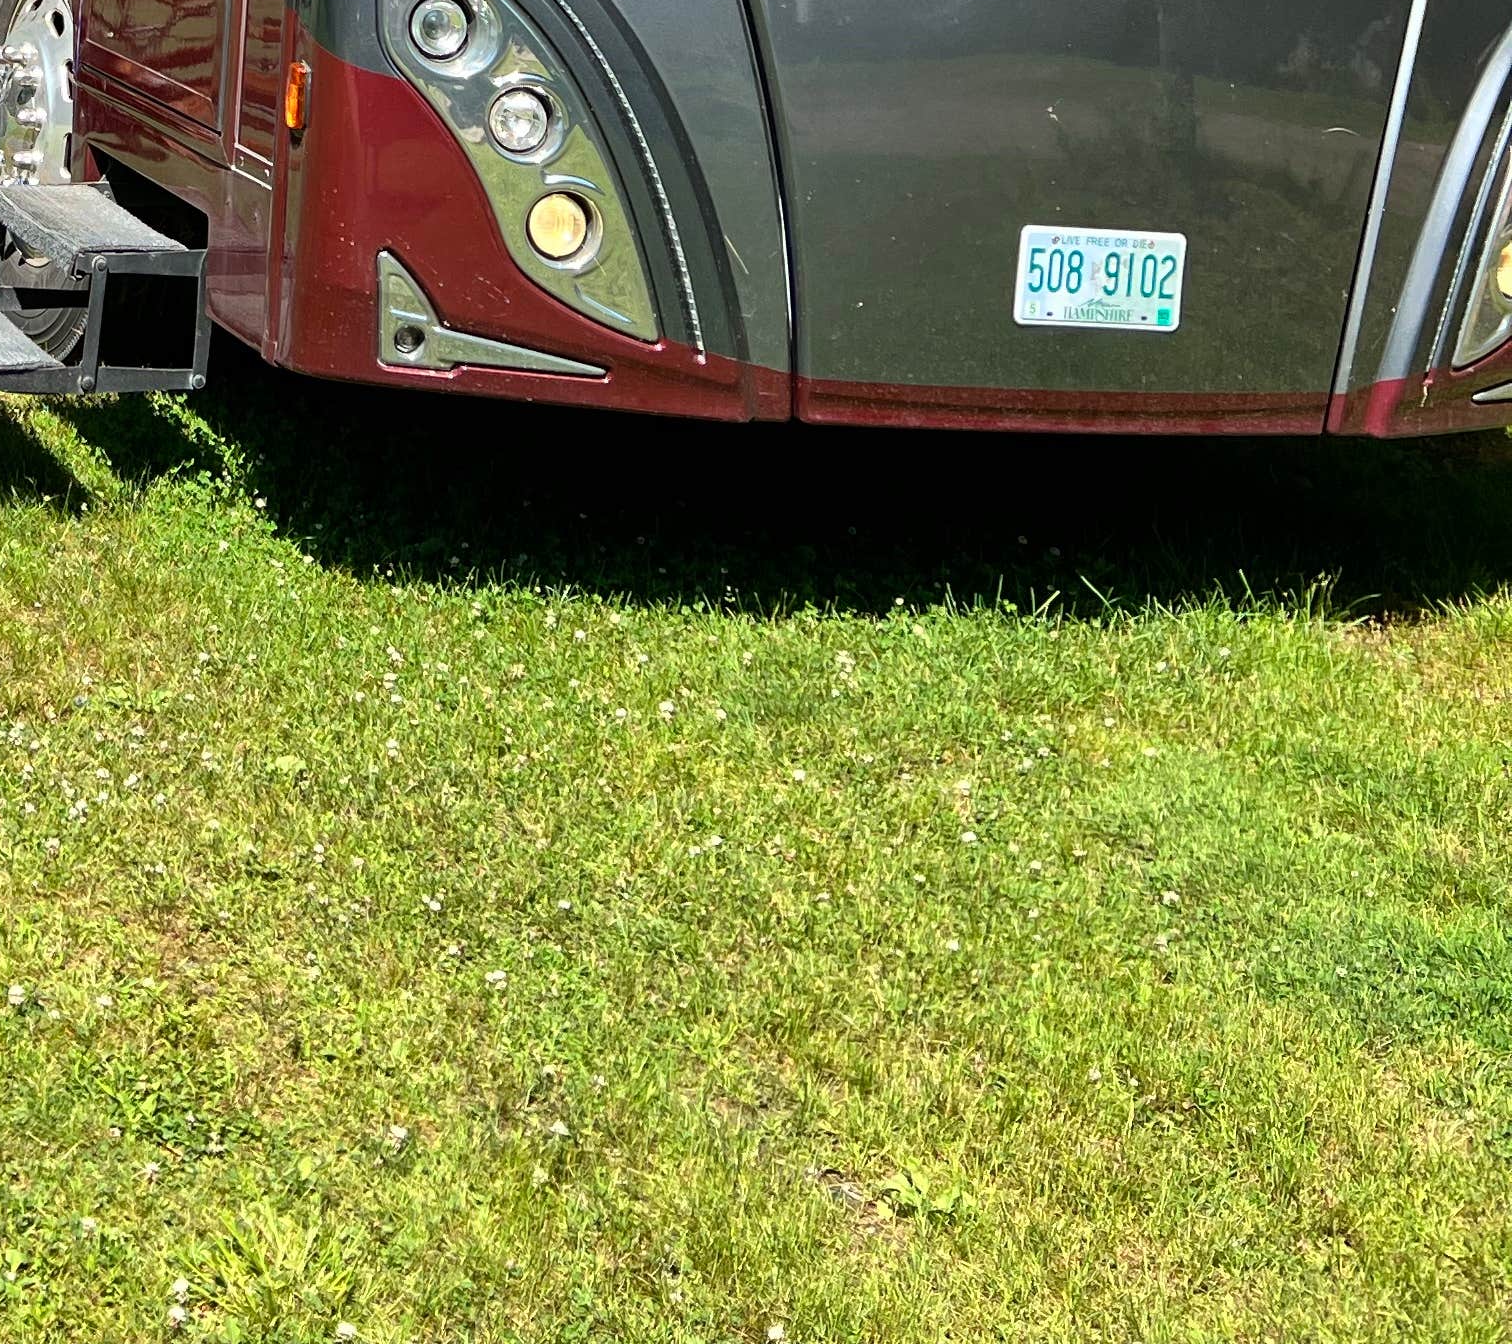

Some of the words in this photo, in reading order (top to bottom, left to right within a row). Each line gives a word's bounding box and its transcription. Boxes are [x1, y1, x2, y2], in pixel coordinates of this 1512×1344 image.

[1061, 236, 1081, 246] LIVE
[1086, 236, 1110, 247] FREE
[1115, 238, 1129, 248] OR
[1133, 239, 1149, 249] DIE
[1028, 248, 1084, 293] 508
[1102, 251, 1178, 299] 9102
